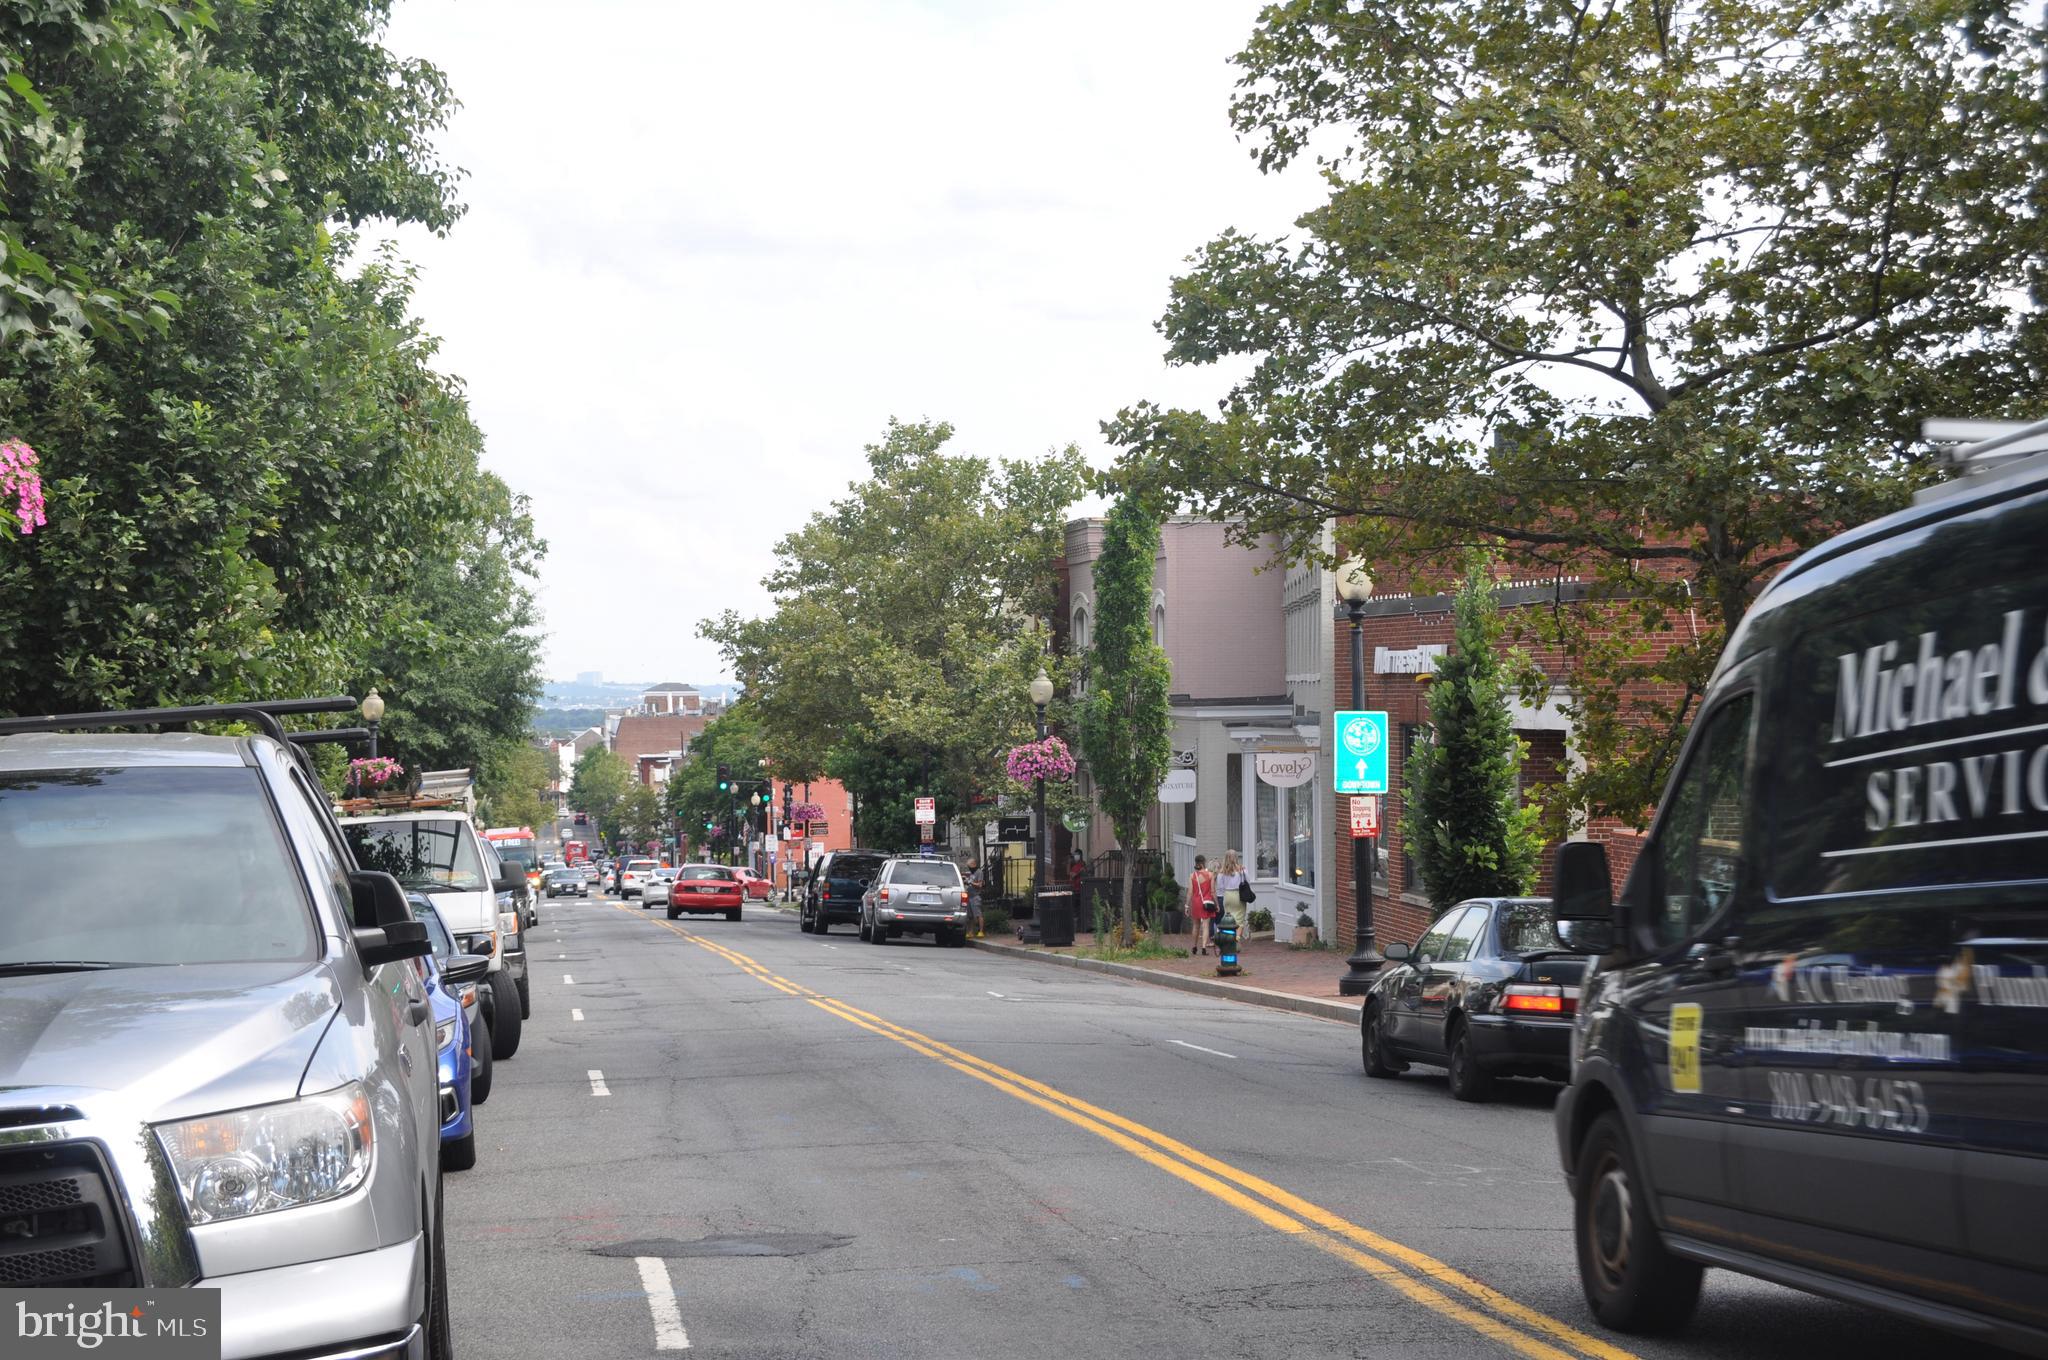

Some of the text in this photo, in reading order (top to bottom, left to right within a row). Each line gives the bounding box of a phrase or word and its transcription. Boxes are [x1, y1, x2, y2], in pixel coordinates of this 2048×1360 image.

[1828, 609, 2025, 743] Michael
[1261, 756, 1312, 779] Lovely
[1342, 780, 1381, 789] DOWNTOWN
